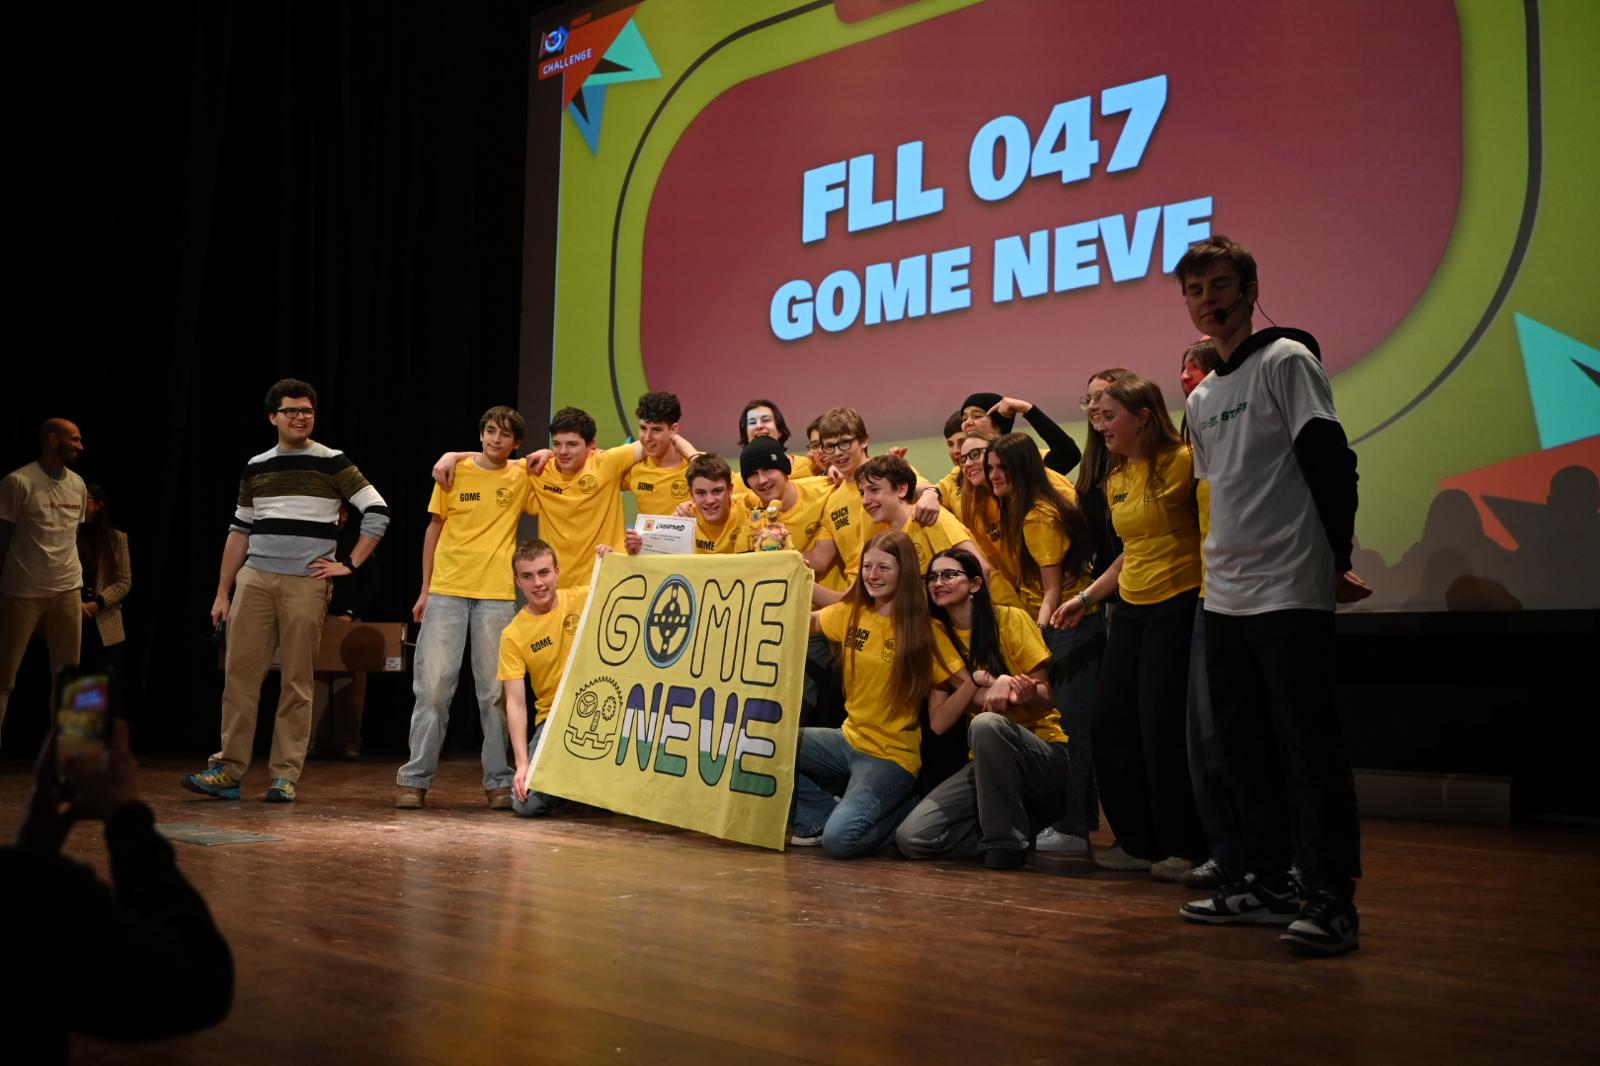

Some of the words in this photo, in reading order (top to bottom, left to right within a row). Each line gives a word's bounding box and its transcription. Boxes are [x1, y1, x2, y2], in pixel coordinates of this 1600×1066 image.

[543, 48, 592, 75] CHALLENGE
[803, 140, 943, 244] FLL
[968, 74, 1168, 201] 047
[769, 245, 971, 341] GOME
[460, 492, 480, 502] GOME
[831, 506, 849, 521] COACH
[835, 516, 850, 531] GOME
[695, 539, 716, 552] GOME
[598, 574, 788, 686] GOME
[530, 636, 553, 653] GOME
